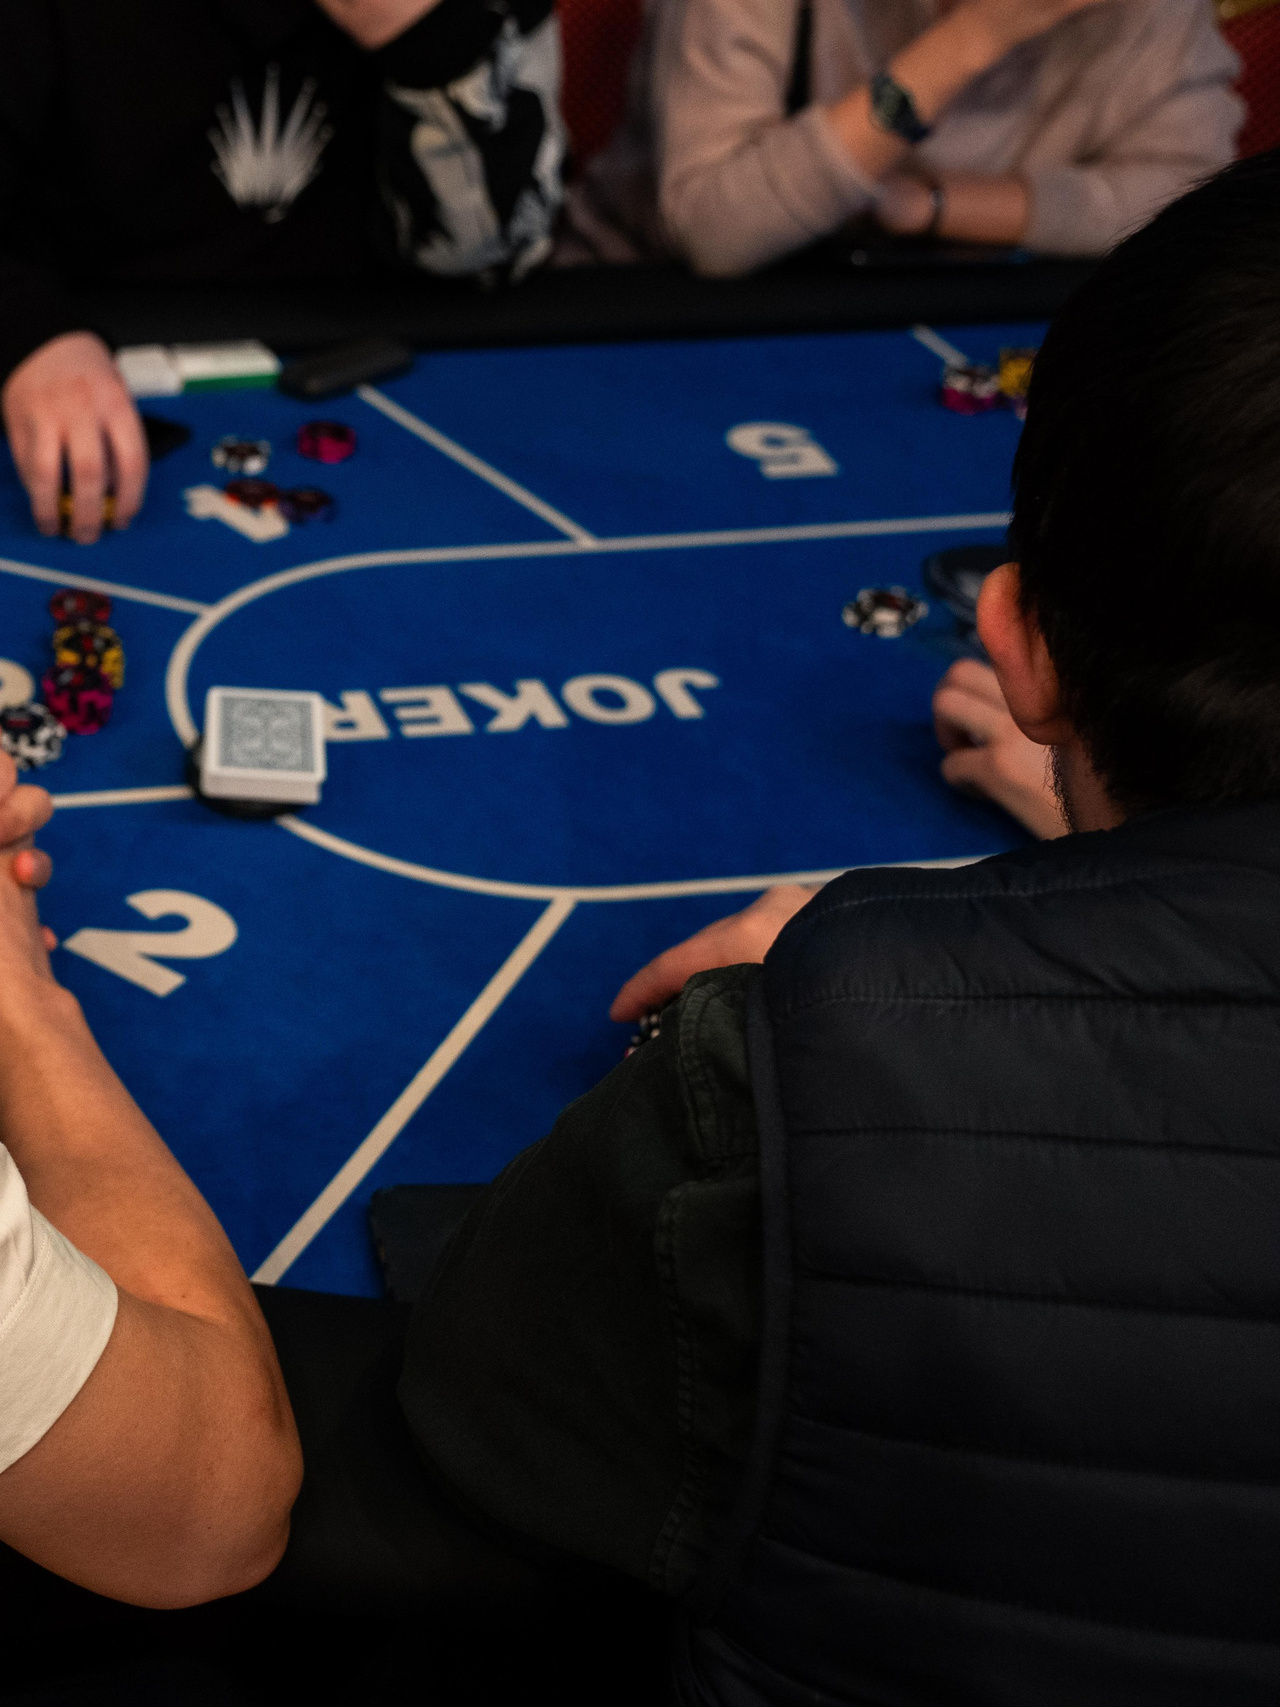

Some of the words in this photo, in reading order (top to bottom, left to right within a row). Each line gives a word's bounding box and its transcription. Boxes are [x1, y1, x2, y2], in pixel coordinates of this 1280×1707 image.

[726, 421, 838, 479] 5
[323, 667, 720, 741] JOKER
[63, 889, 238, 998] 2
